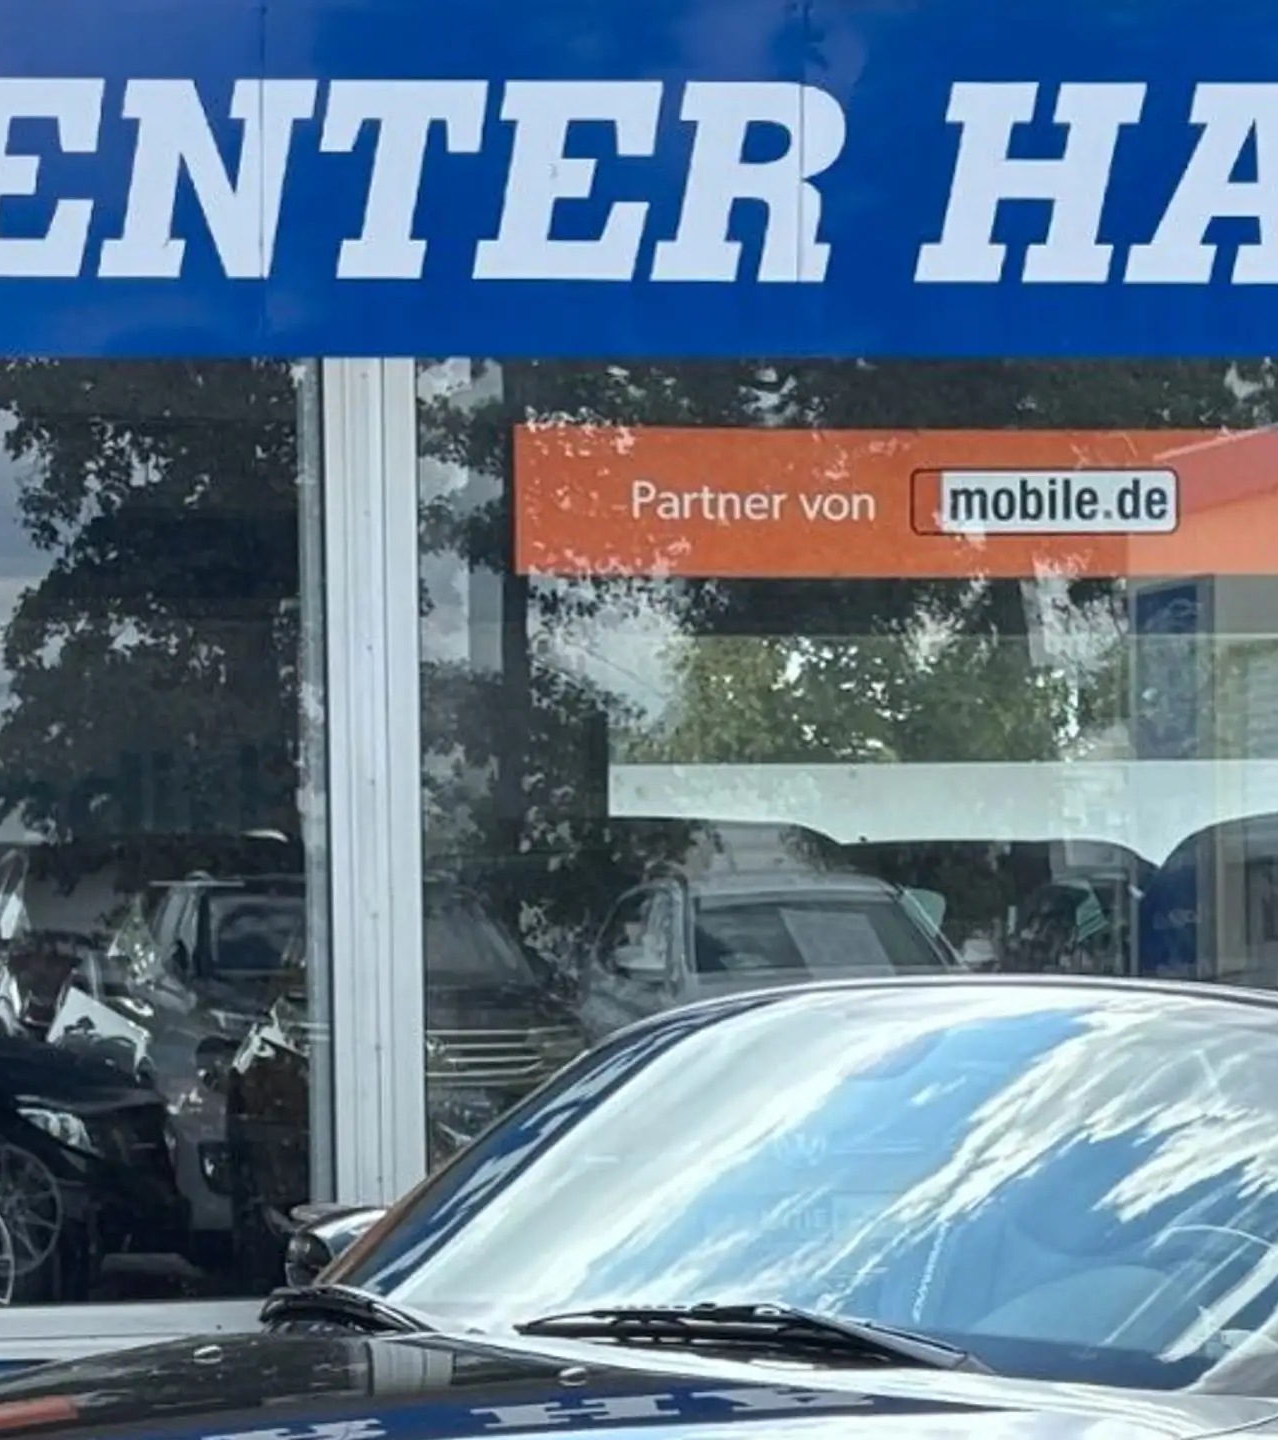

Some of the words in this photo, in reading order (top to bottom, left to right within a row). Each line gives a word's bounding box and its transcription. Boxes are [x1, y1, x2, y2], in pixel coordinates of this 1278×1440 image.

[631, 481, 787, 521] Partner
[799, 493, 876, 521] von
[948, 477, 1169, 522] mobile.de
